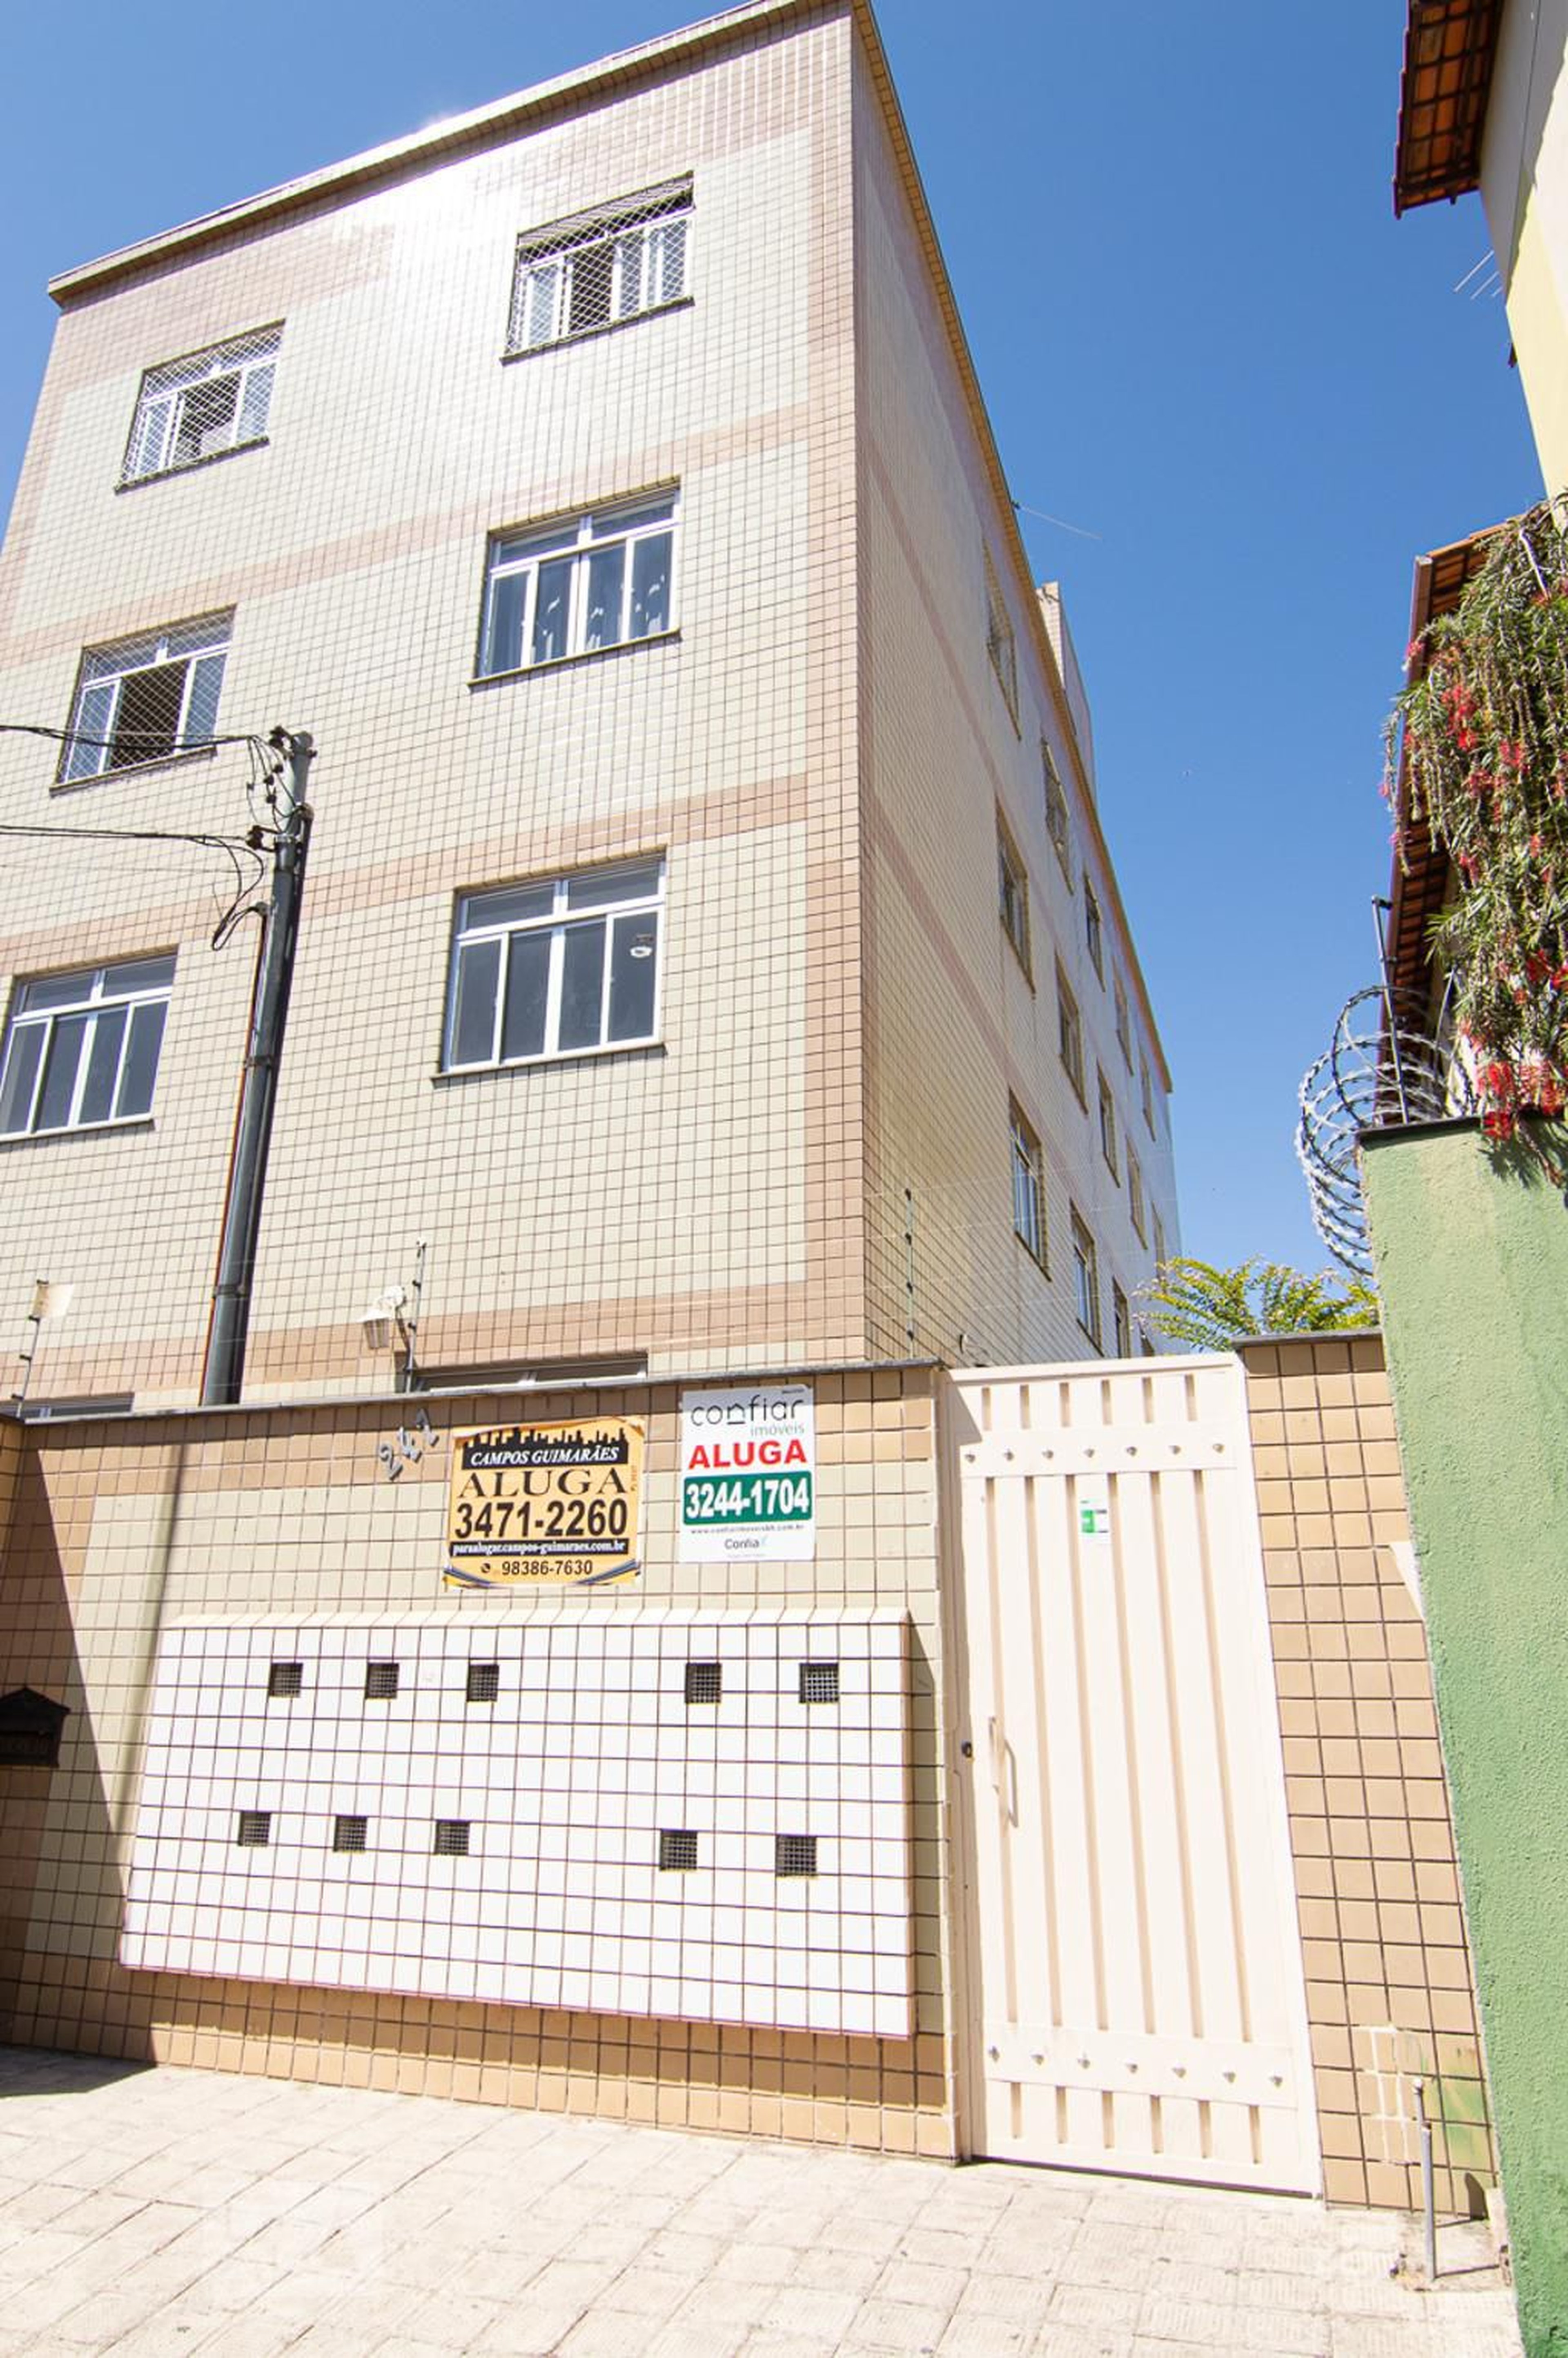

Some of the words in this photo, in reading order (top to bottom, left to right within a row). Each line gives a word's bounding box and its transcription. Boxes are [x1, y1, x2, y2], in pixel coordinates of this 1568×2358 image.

[691, 1394, 804, 1426] confiar
[471, 1451, 529, 1466] CAMPOS
[531, 1445, 619, 1463] GUIMARÃES
[688, 1438, 807, 1470] ALUGA
[458, 1467, 628, 1499] ALUGA
[686, 1477, 810, 1519] 3244-1704
[454, 1498, 628, 1539] 3471-2260
[501, 1559, 593, 1576] 98386-7630
